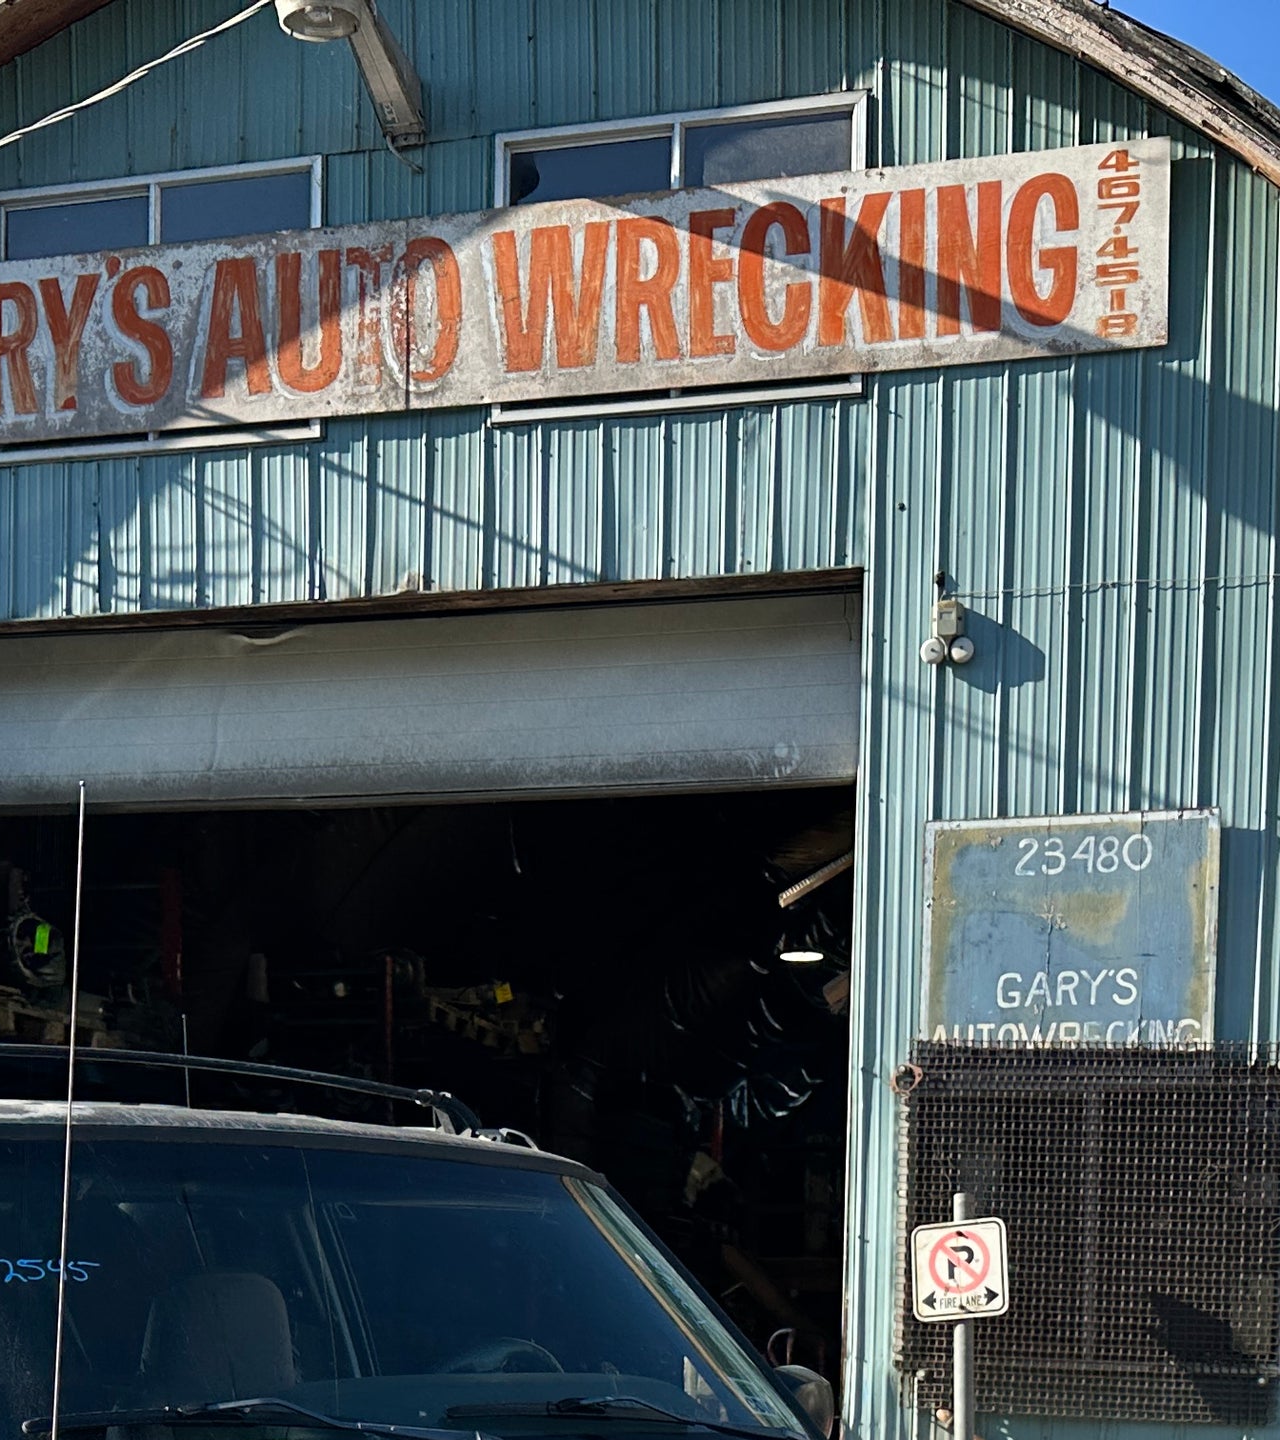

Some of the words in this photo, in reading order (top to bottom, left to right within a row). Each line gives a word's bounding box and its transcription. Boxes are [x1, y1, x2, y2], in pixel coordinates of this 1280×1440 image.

[200, 236, 463, 398] AUTO
[491, 172, 1080, 372] WRECKING
[1014, 833, 1154, 877] 23480
[995, 966, 1140, 1010] GARY'S
[939, 1296, 957, 1310] FIRE
